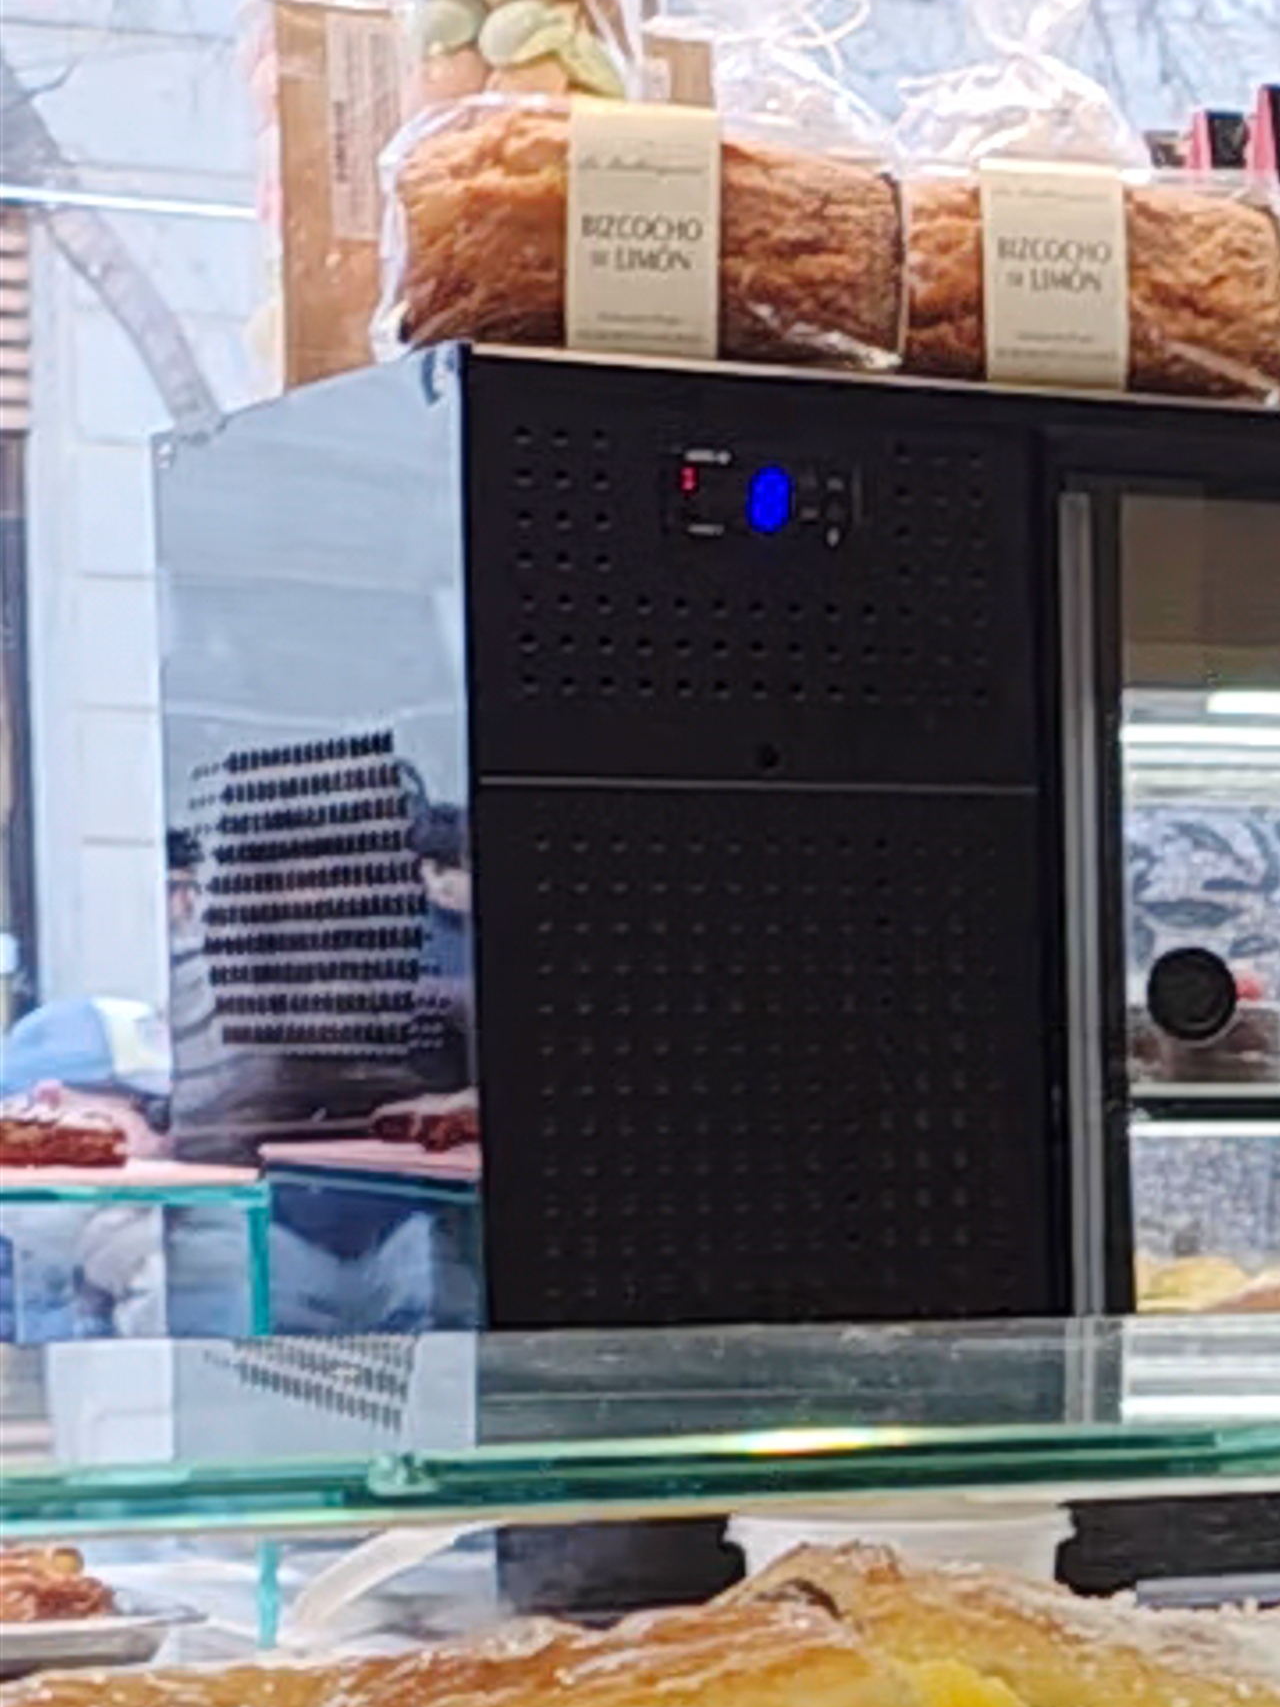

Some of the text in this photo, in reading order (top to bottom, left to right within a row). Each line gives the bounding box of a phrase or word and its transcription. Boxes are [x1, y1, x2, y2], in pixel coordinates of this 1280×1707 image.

[581, 214, 704, 242] BIZCOCHO
[615, 244, 692, 272] LIMÓN
[997, 236, 1113, 264] BIZCOCHO
[1030, 264, 1103, 294] LIMÓN
